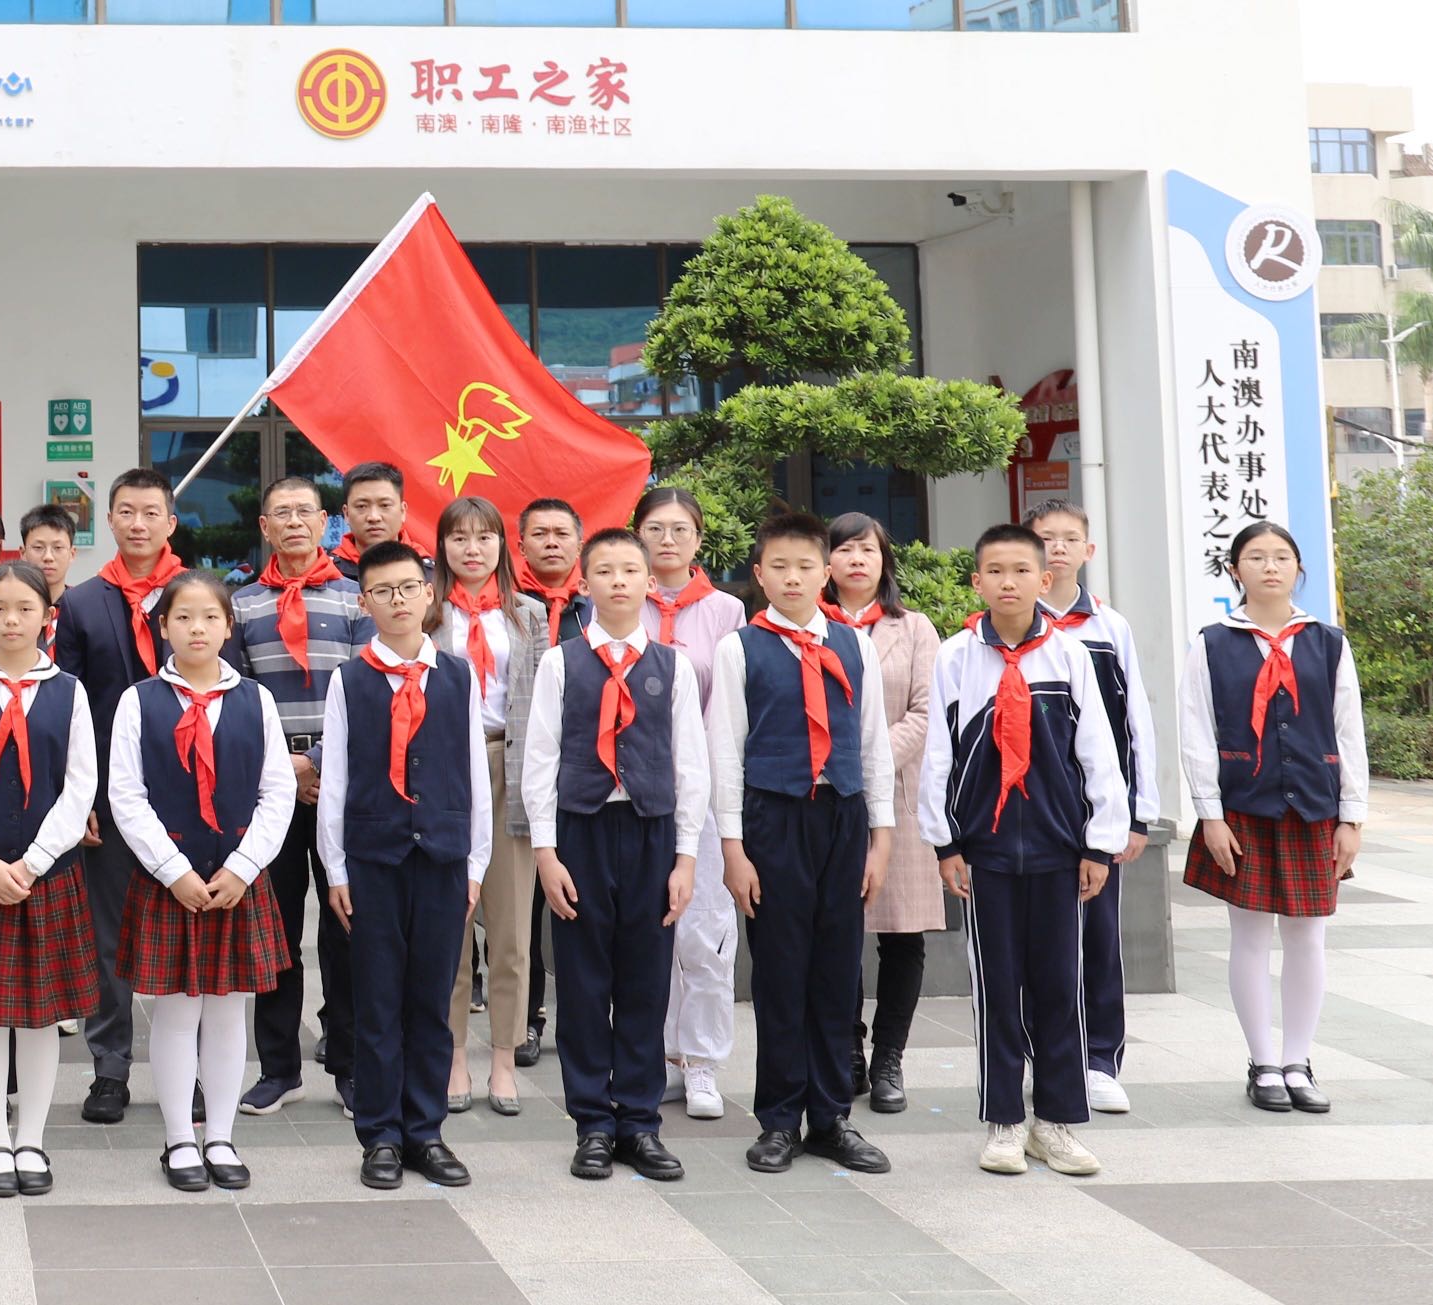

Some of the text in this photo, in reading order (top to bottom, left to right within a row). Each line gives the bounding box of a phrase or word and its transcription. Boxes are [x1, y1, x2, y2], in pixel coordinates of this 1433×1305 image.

[410, 57, 631, 111] 职工之家
[54, 402, 69, 411] AED
[73, 402, 87, 410] AED
[1230, 339, 1268, 520] 南澳办事处
[1196, 358, 1232, 578] 人大代表之家
[61, 488, 80, 496] AED
